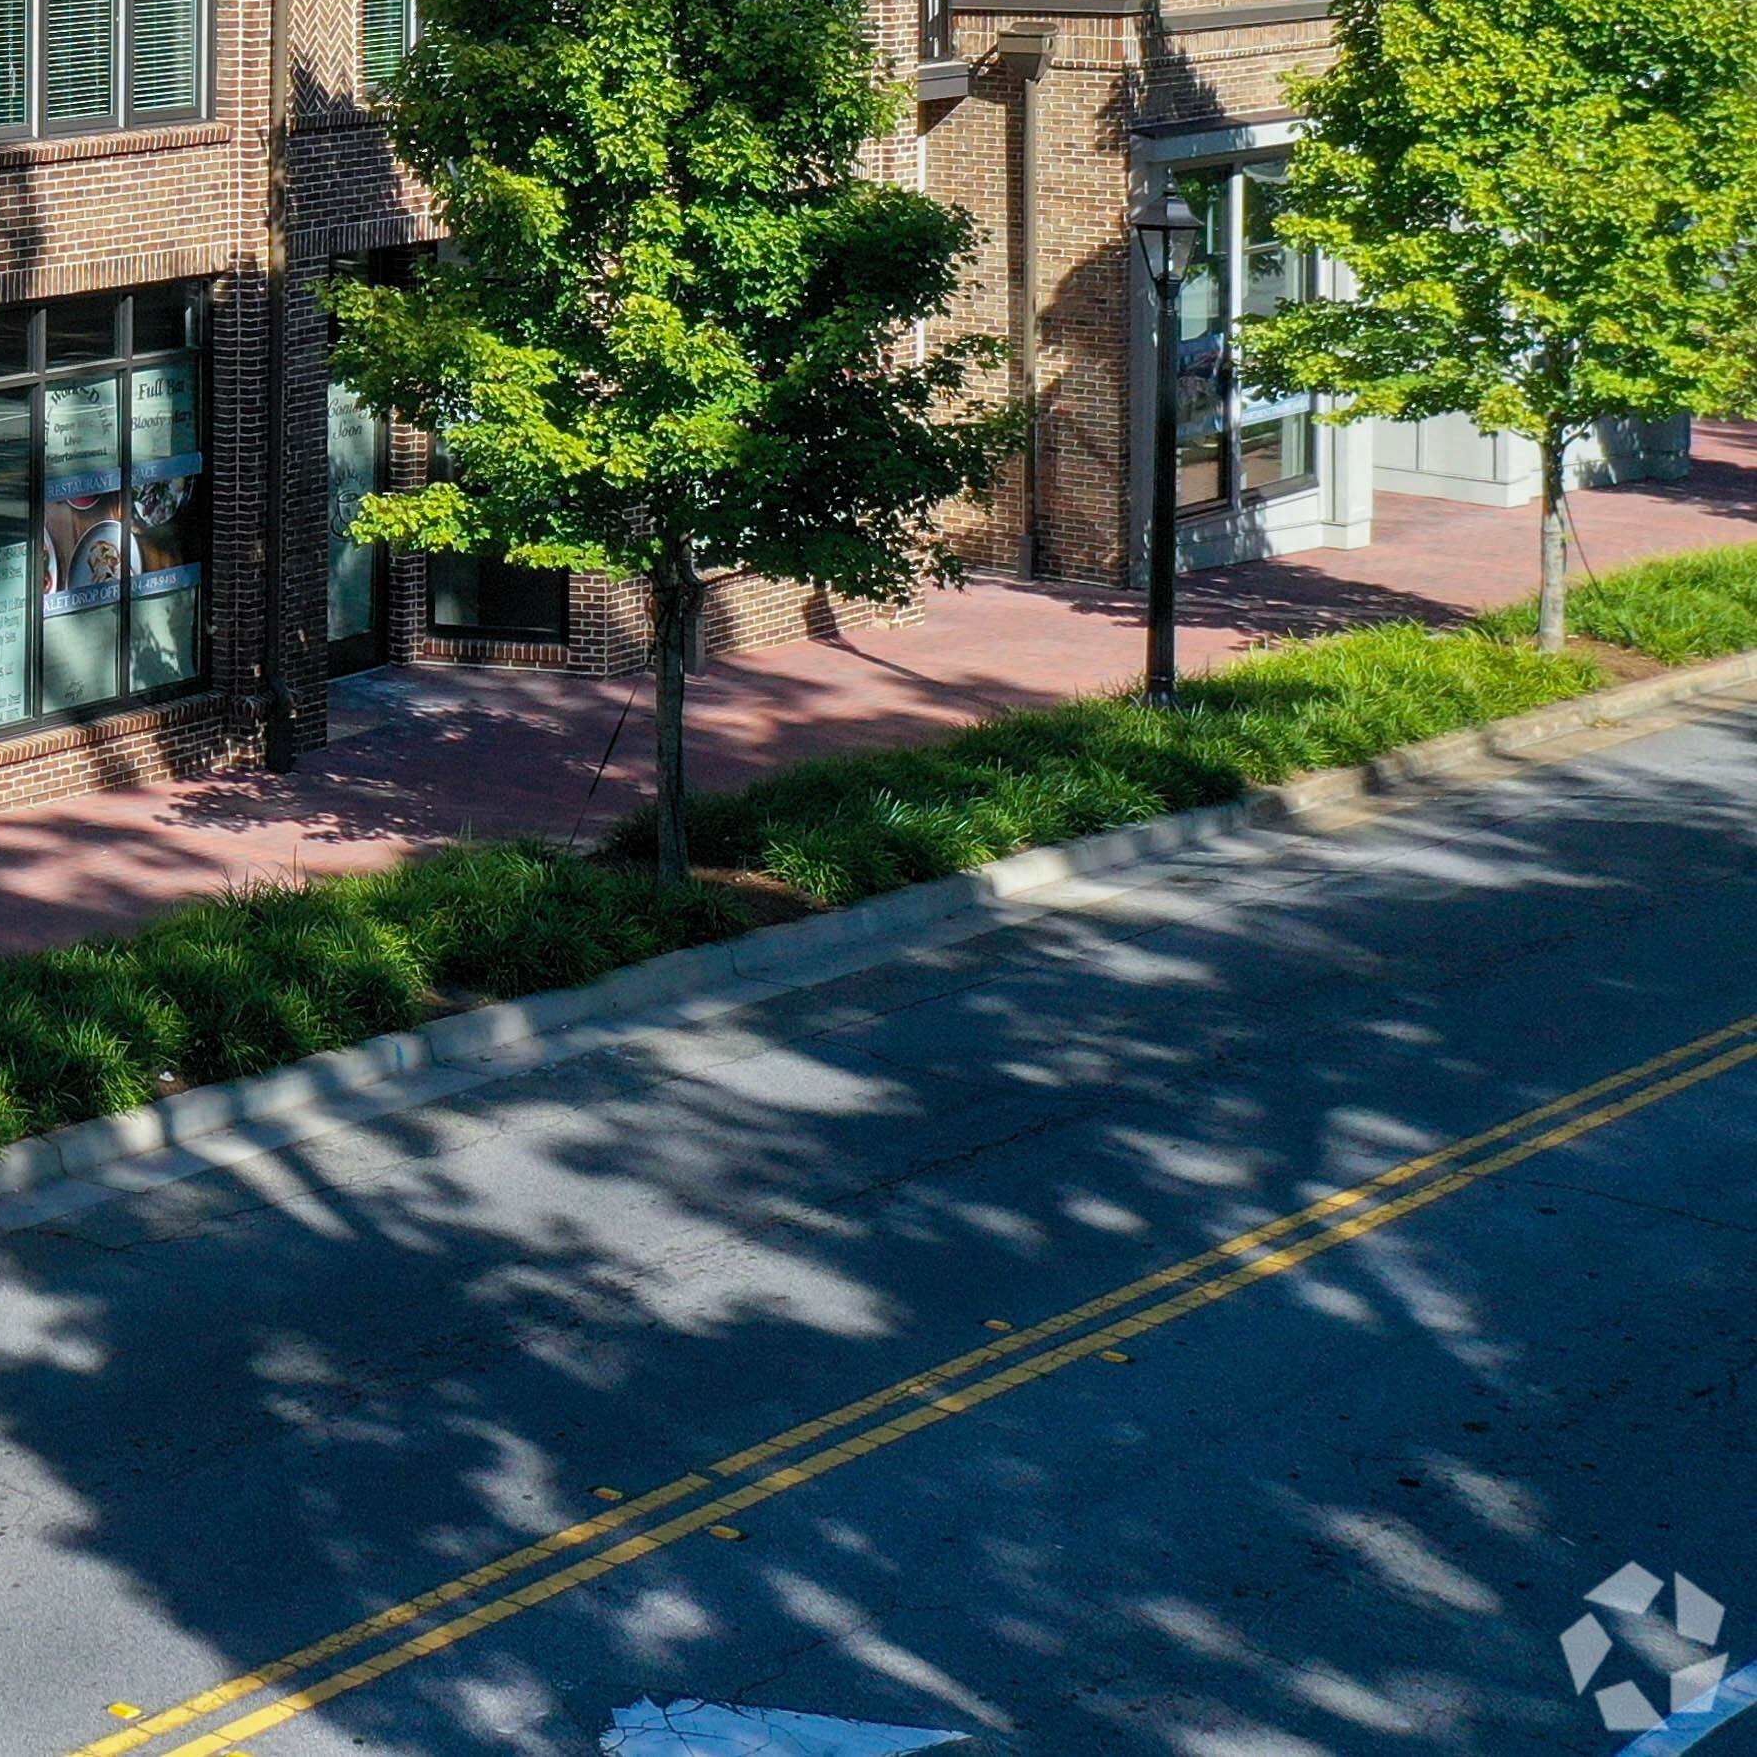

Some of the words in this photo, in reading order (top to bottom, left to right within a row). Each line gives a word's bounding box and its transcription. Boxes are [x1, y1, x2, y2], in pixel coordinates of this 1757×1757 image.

[138, 378, 163, 400] Full
[332, 419, 363, 440] Soon
[48, 473, 113, 497] RESTAURANT
[43, 595, 70, 611] ALET
[71, 590, 99, 607] DROP
